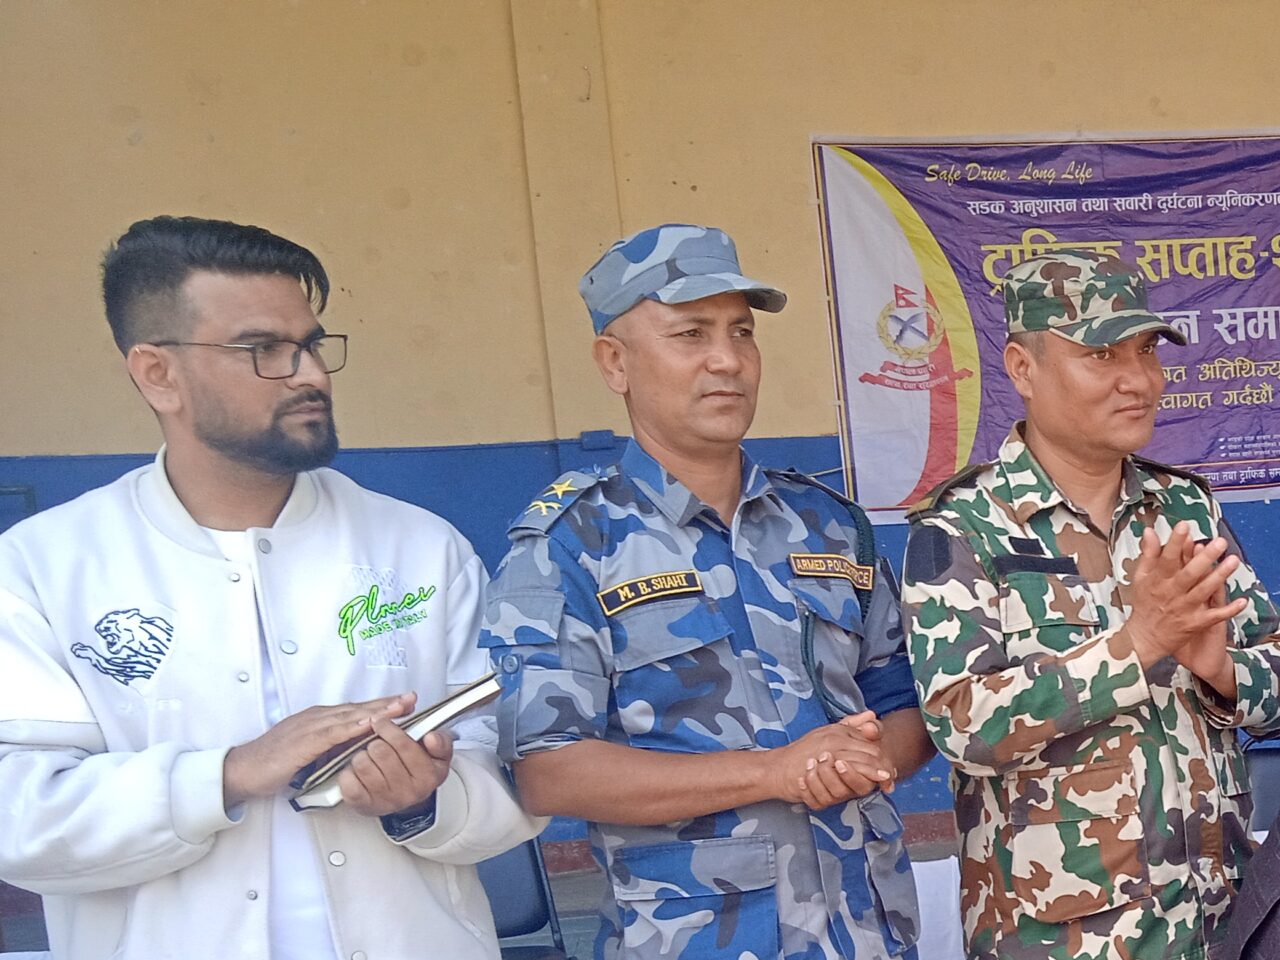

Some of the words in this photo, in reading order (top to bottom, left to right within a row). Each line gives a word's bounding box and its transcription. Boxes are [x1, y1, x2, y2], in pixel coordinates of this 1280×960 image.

[924, 163, 961, 186] Safe
[1018, 161, 1056, 185] Long
[1061, 161, 1093, 185] Life
[967, 200, 1006, 215] सडक
[1010, 199, 1077, 217] अनुशासन
[1081, 198, 1110, 212] तथा
[1113, 193, 1152, 211] सवारी
[1157, 191, 1203, 214] दुर्घटना
[1157, 391, 1212, 411] वागत
[796, 559, 826, 571] ARMED
[617, 586, 635, 601] M.
[637, 581, 651, 595] B.
[651, 574, 688, 590] SHAHI
